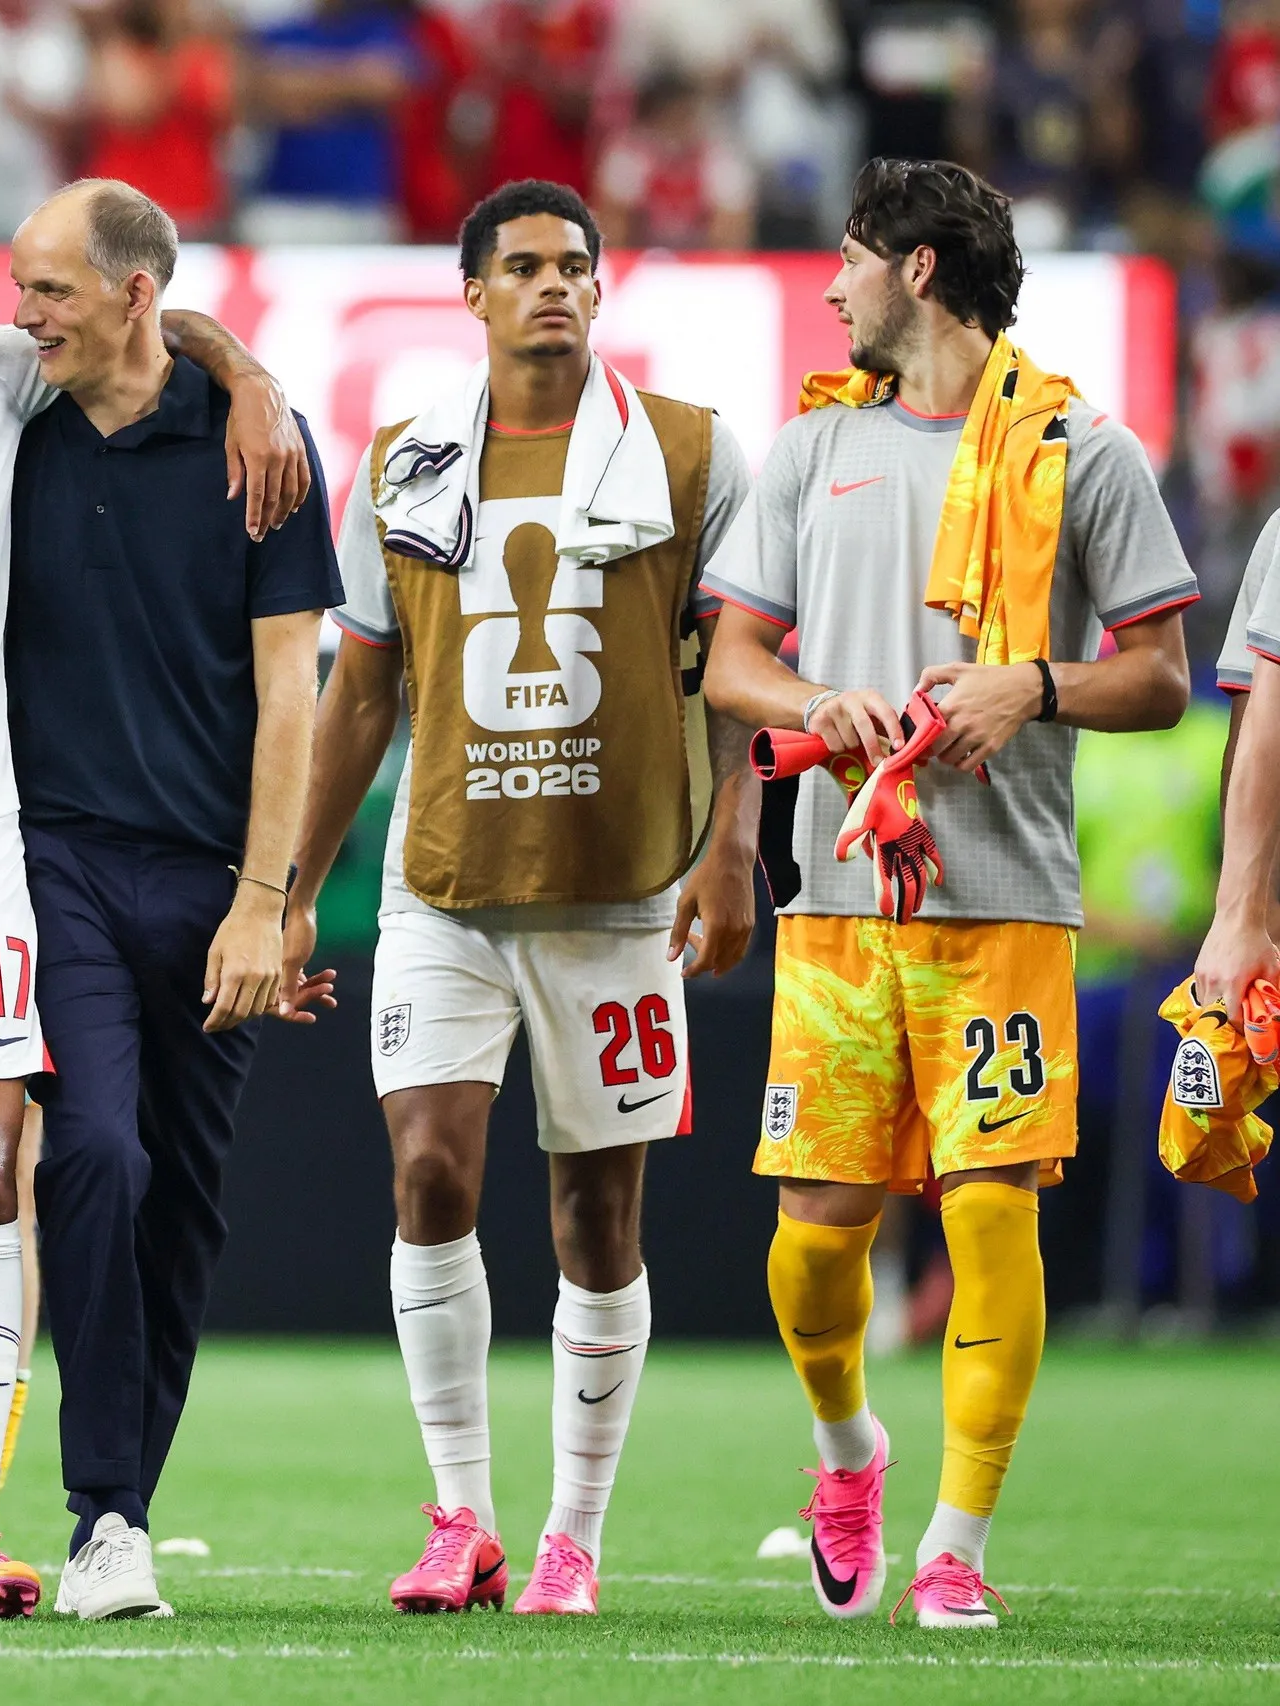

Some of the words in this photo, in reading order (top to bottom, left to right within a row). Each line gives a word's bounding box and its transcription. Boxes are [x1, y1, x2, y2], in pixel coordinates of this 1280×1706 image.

[505, 683, 569, 709] FIFA
[464, 739, 556, 763] WORLD
[560, 737, 602, 759] CUP
[465, 763, 601, 800] 2026
[592, 992, 677, 1088] 26
[964, 1011, 1045, 1102] 23
